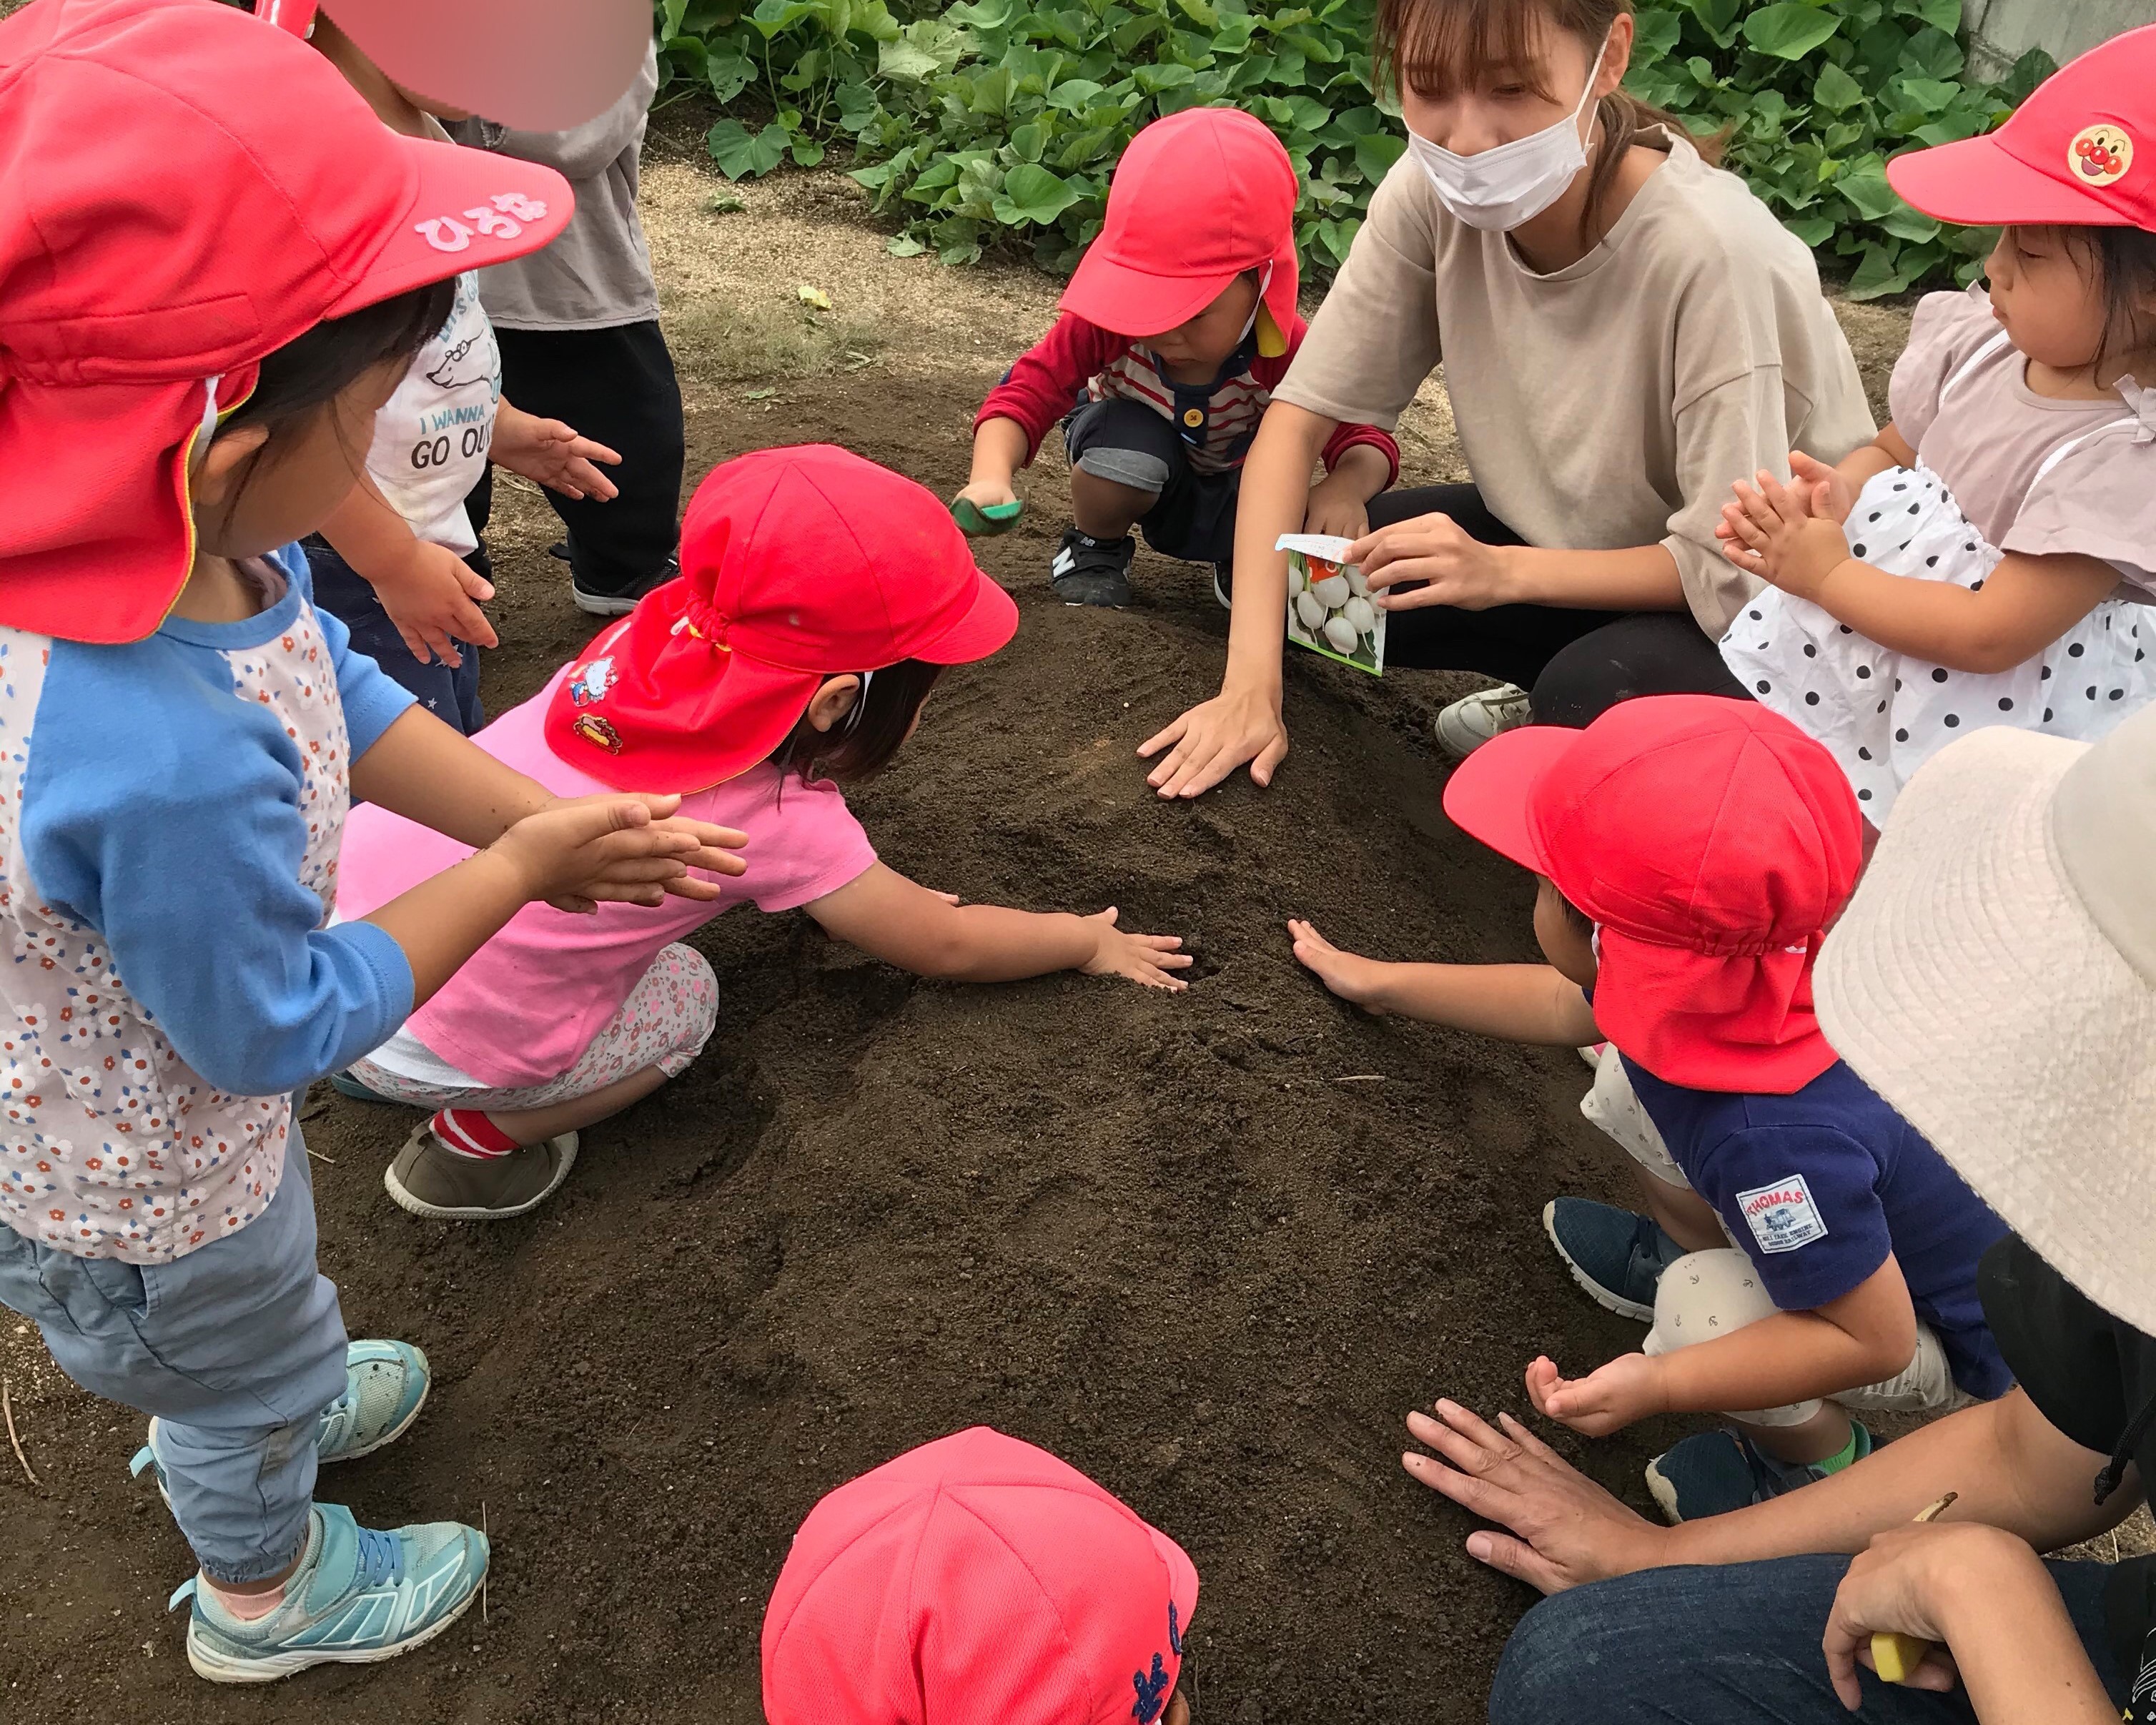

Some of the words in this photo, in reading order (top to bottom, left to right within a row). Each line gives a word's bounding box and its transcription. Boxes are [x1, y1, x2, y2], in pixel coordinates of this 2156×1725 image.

[420, 417, 427, 435] I
[432, 404, 485, 431] WANNA
[411, 435, 450, 469] GO
[1746, 1190, 1804, 1217] THOMAS
[1784, 1230, 1811, 1244] RAILWAY
[1789, 1223, 1814, 1236] ENGINE
